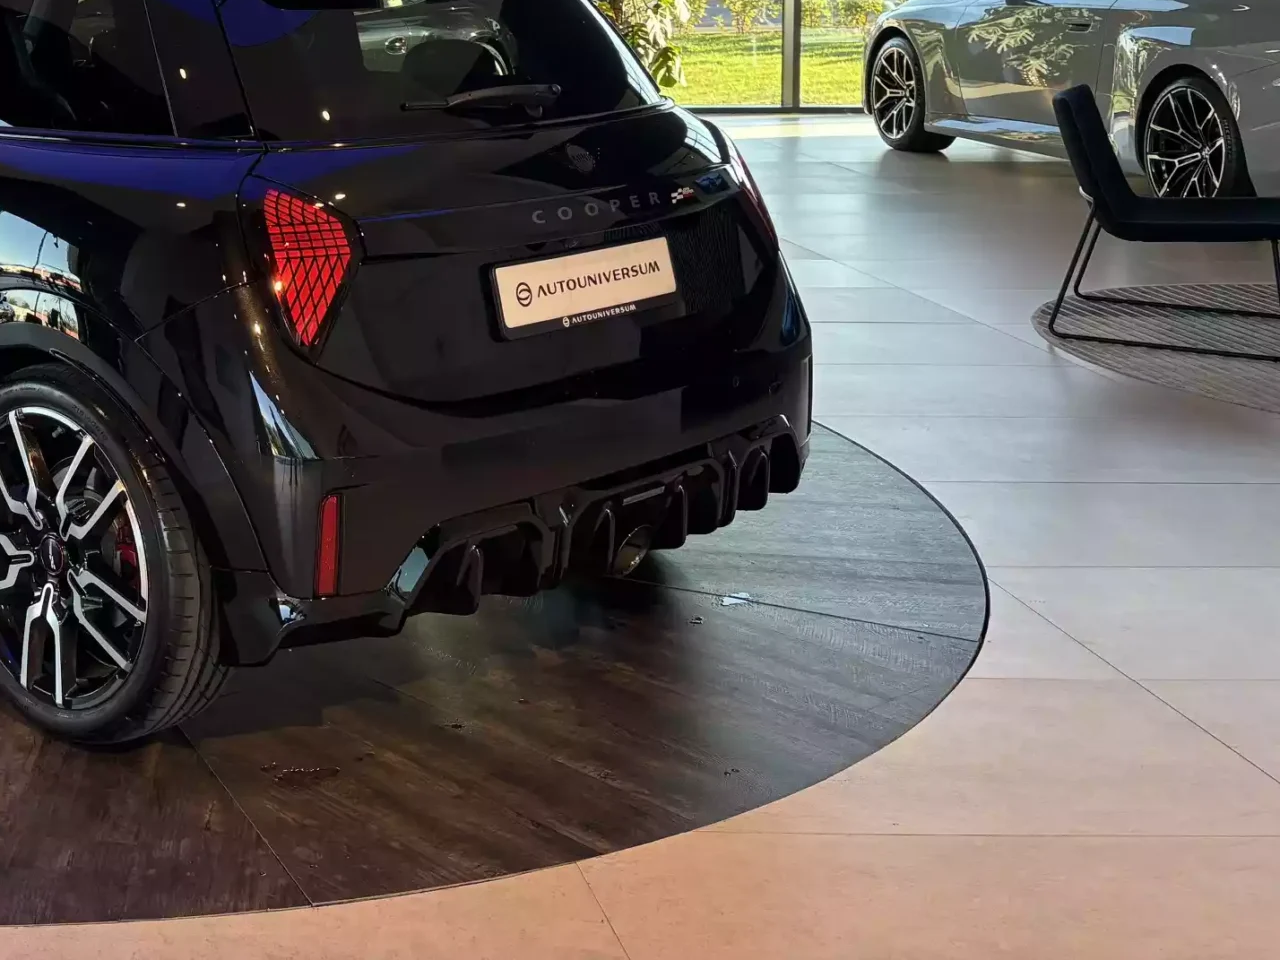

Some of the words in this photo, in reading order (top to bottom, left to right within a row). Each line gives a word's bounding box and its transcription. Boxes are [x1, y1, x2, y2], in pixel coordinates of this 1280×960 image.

[532, 192, 660, 224] COOPER
[537, 260, 660, 298] AUTOUNIVERSUM
[572, 303, 636, 324] AUTOUNIVERSUM
